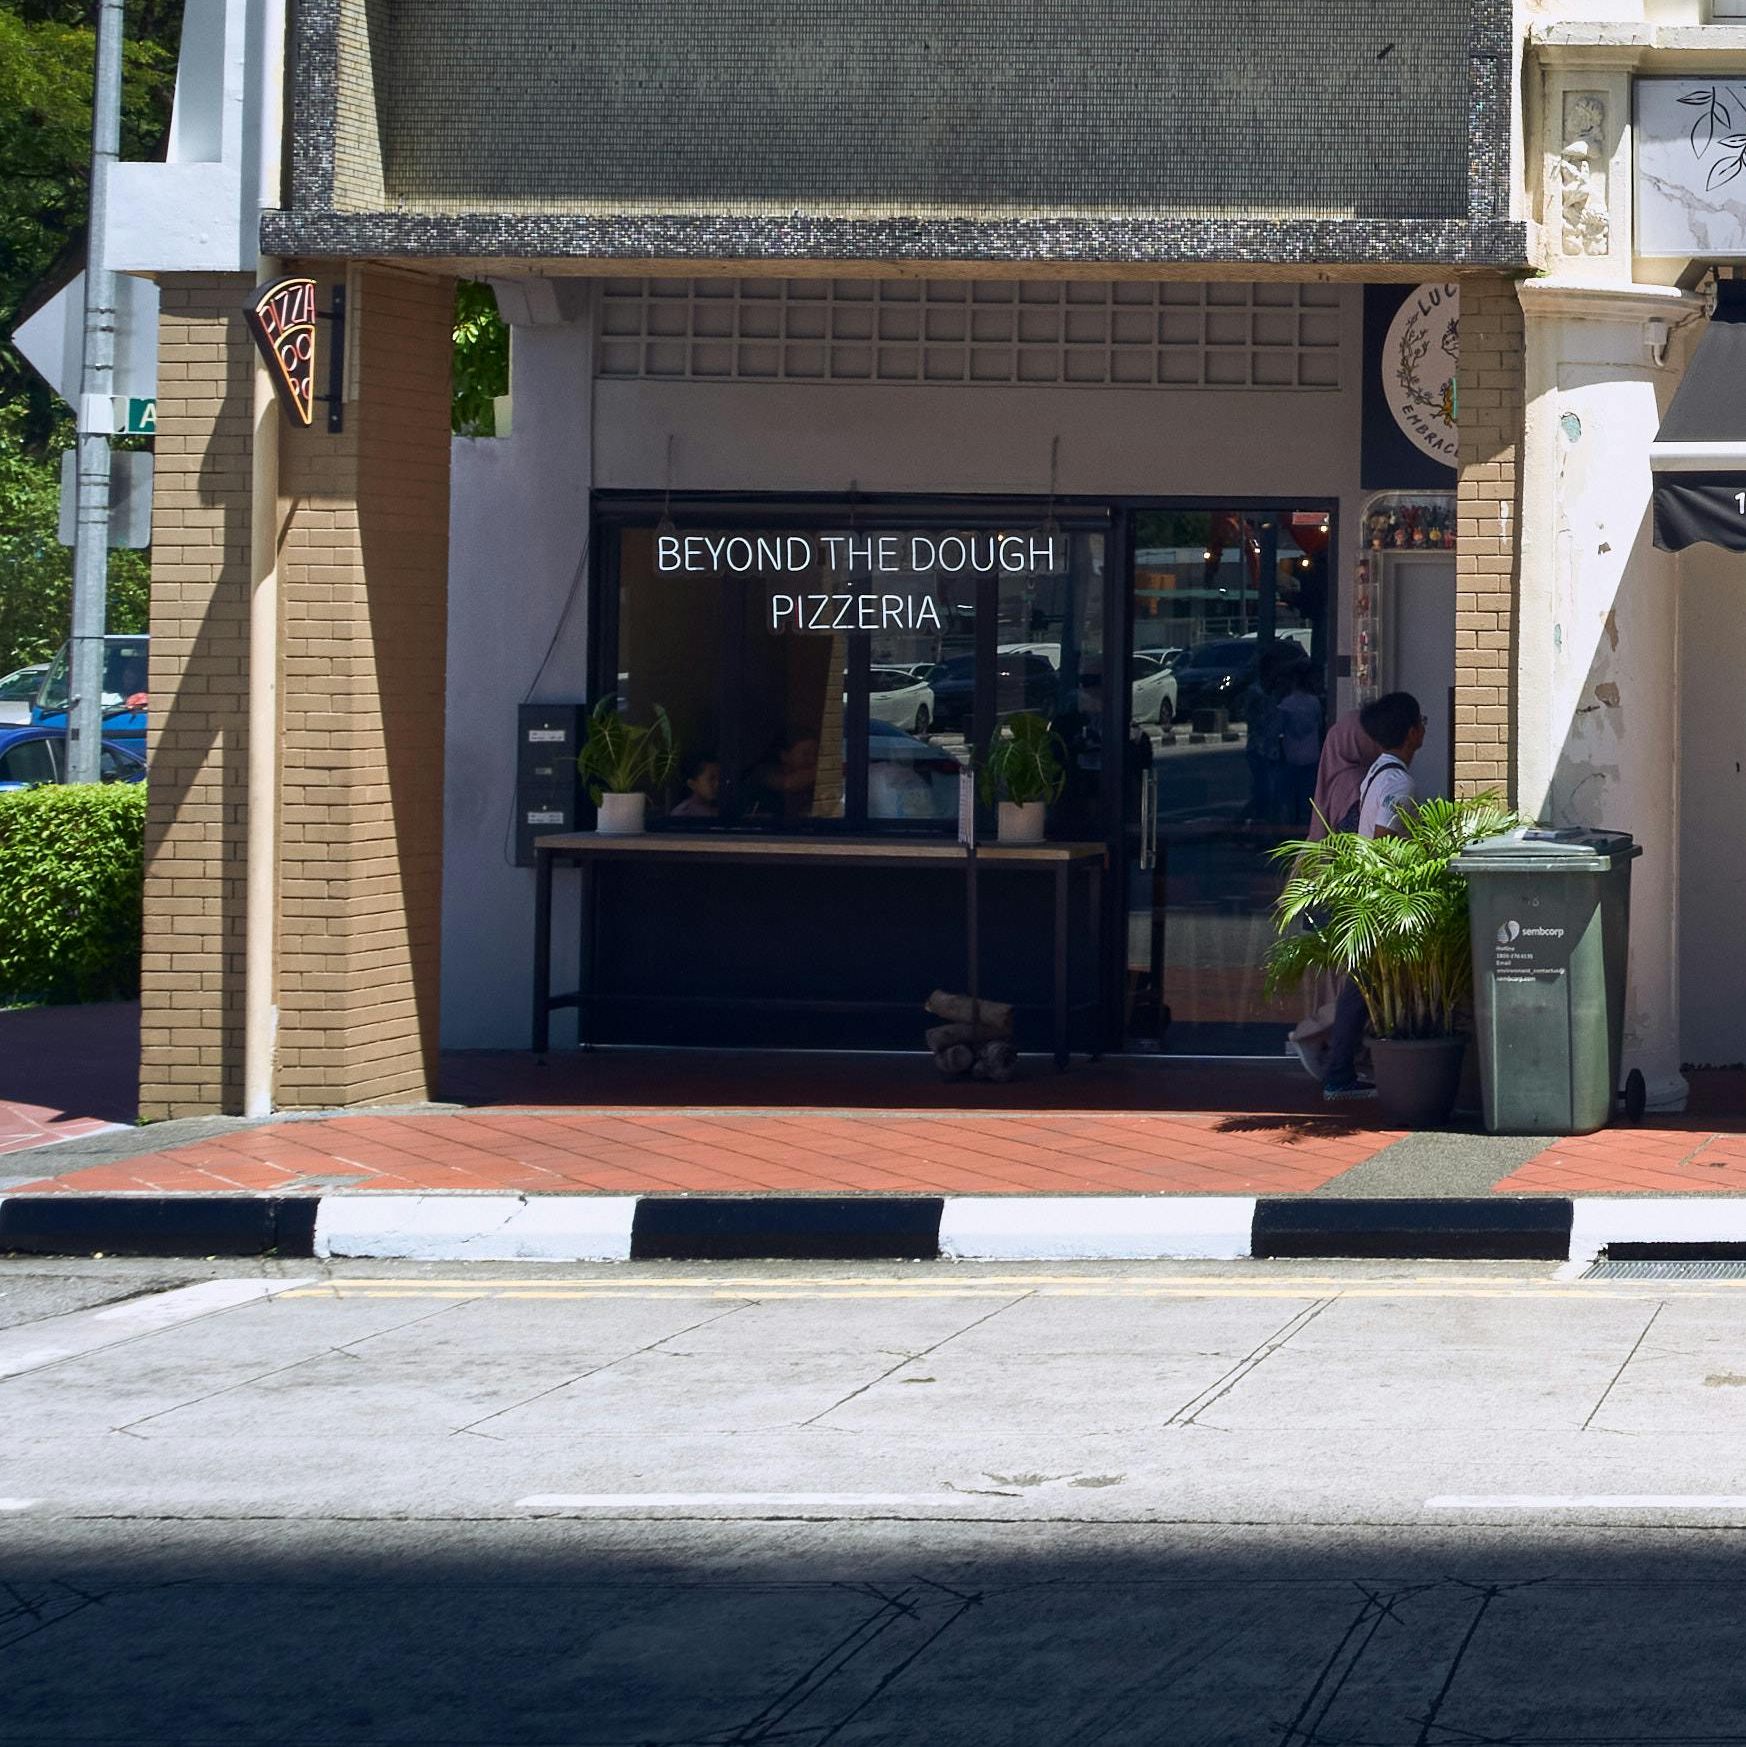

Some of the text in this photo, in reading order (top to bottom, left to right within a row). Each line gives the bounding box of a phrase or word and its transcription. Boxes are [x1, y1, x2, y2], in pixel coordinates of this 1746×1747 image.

[258, 282, 316, 334] PIZZA
[657, 536, 1055, 572] BEYOND THE DOUGH
[772, 594, 942, 631] PIZZERIA
[1521, 926, 1565, 938] sembcorp
